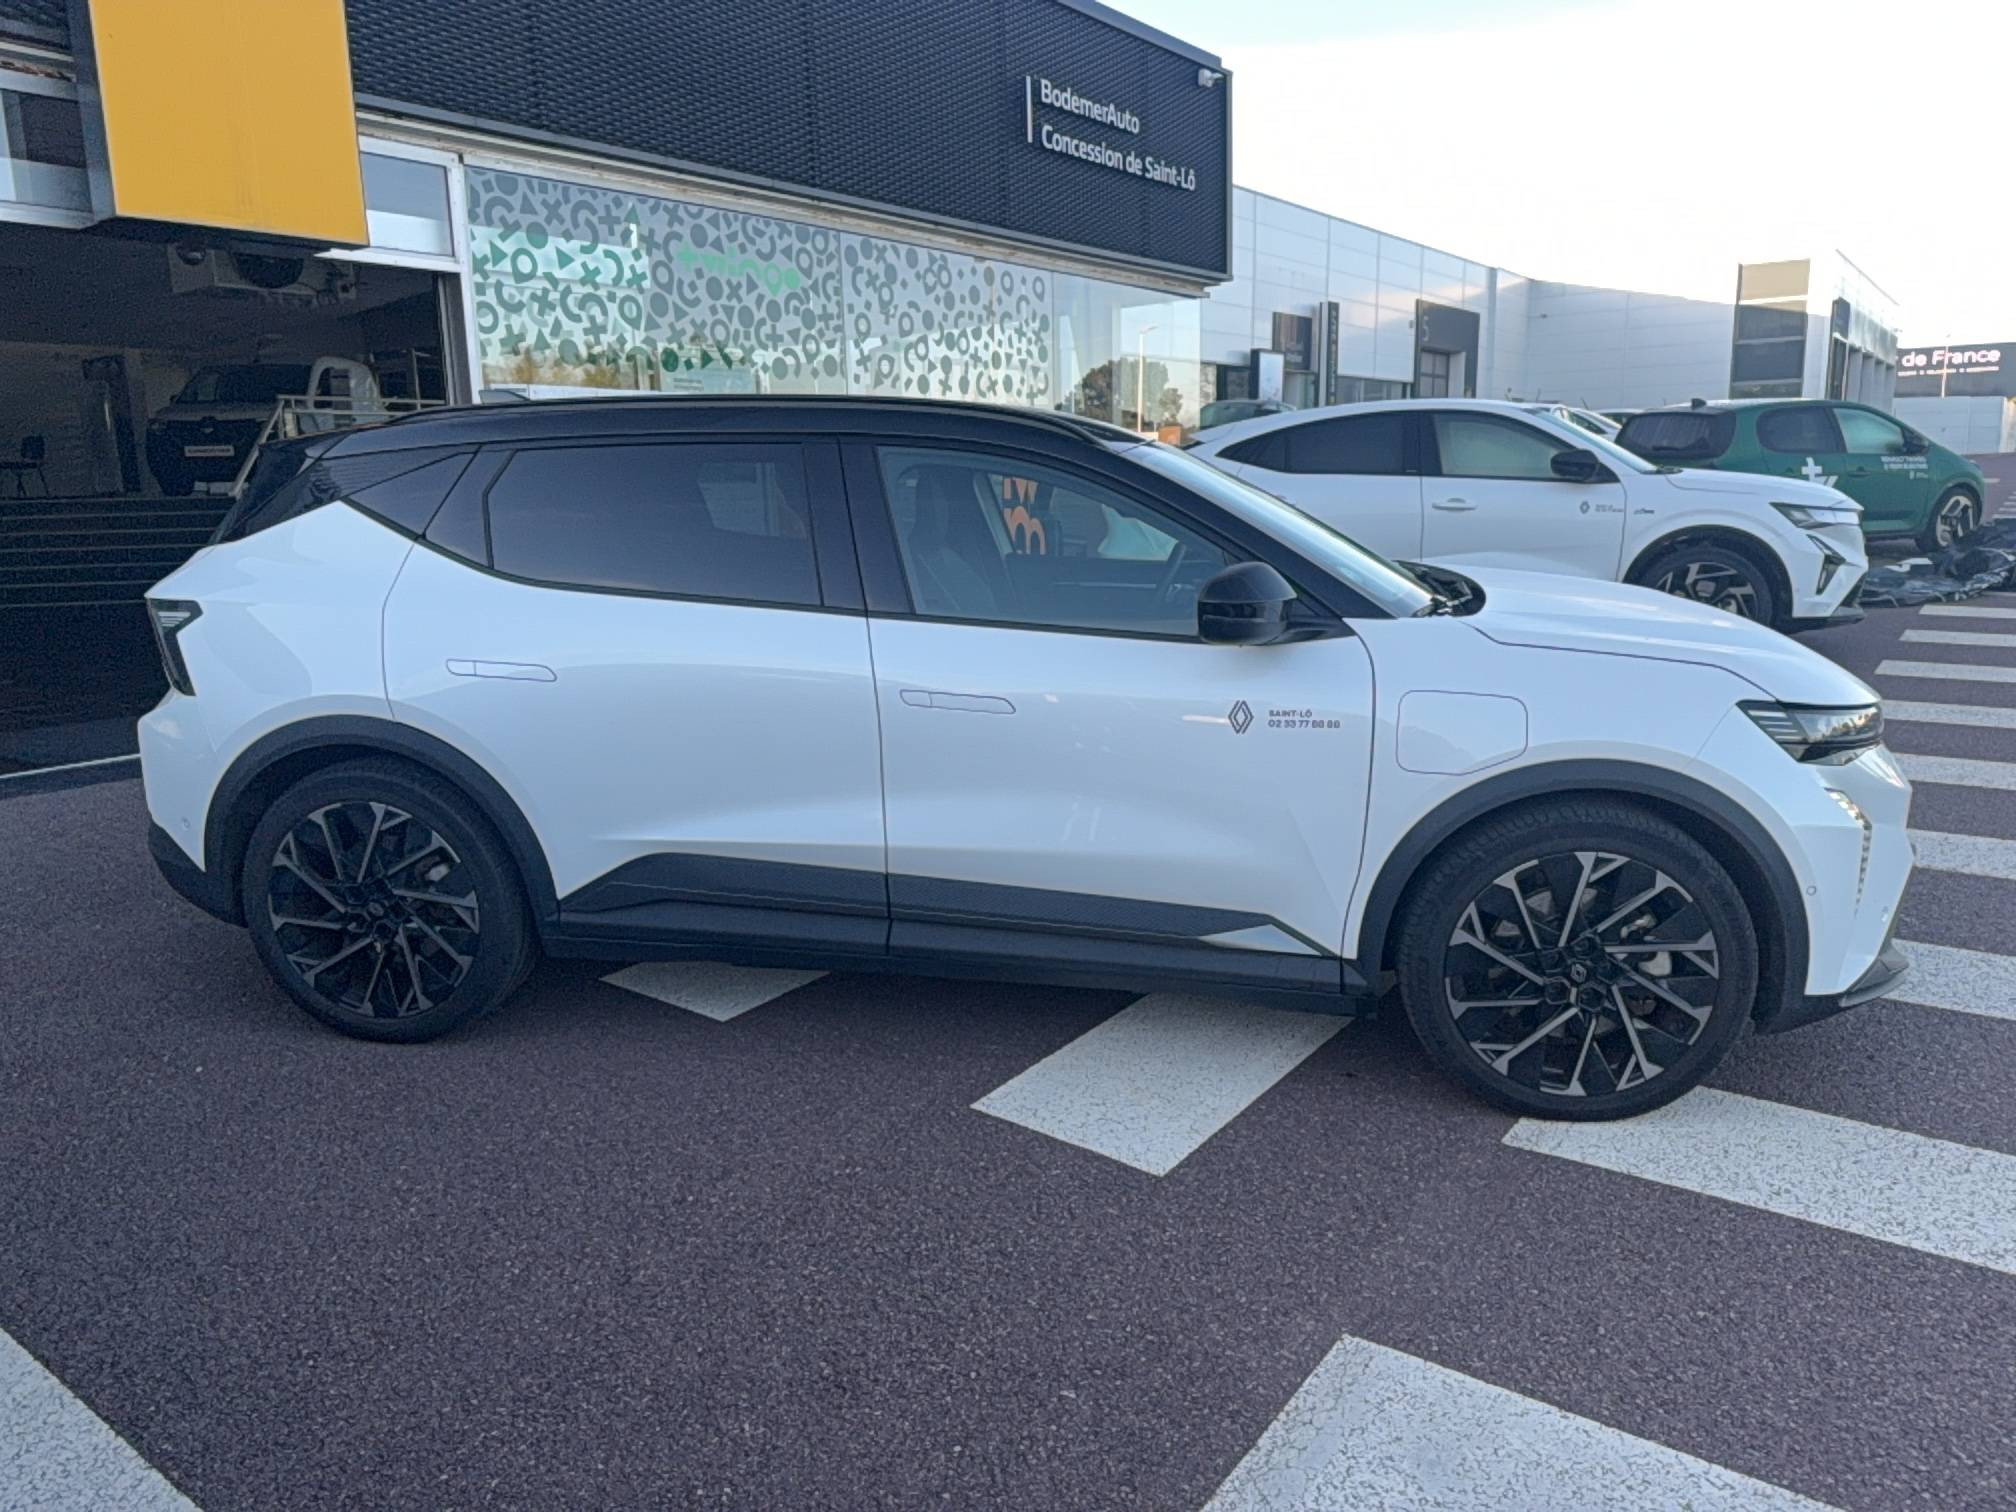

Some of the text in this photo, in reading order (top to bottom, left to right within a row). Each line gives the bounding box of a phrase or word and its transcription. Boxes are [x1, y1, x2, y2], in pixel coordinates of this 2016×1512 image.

[1040, 78, 1140, 134] BodemerAuto
[1041, 125, 1196, 191] Concession de Saint-Lô
[1901, 349, 2001, 367] de France
[1267, 719, 1282, 728] 02
[1284, 719, 1297, 728] 33
[1298, 719, 1309, 728] 77
